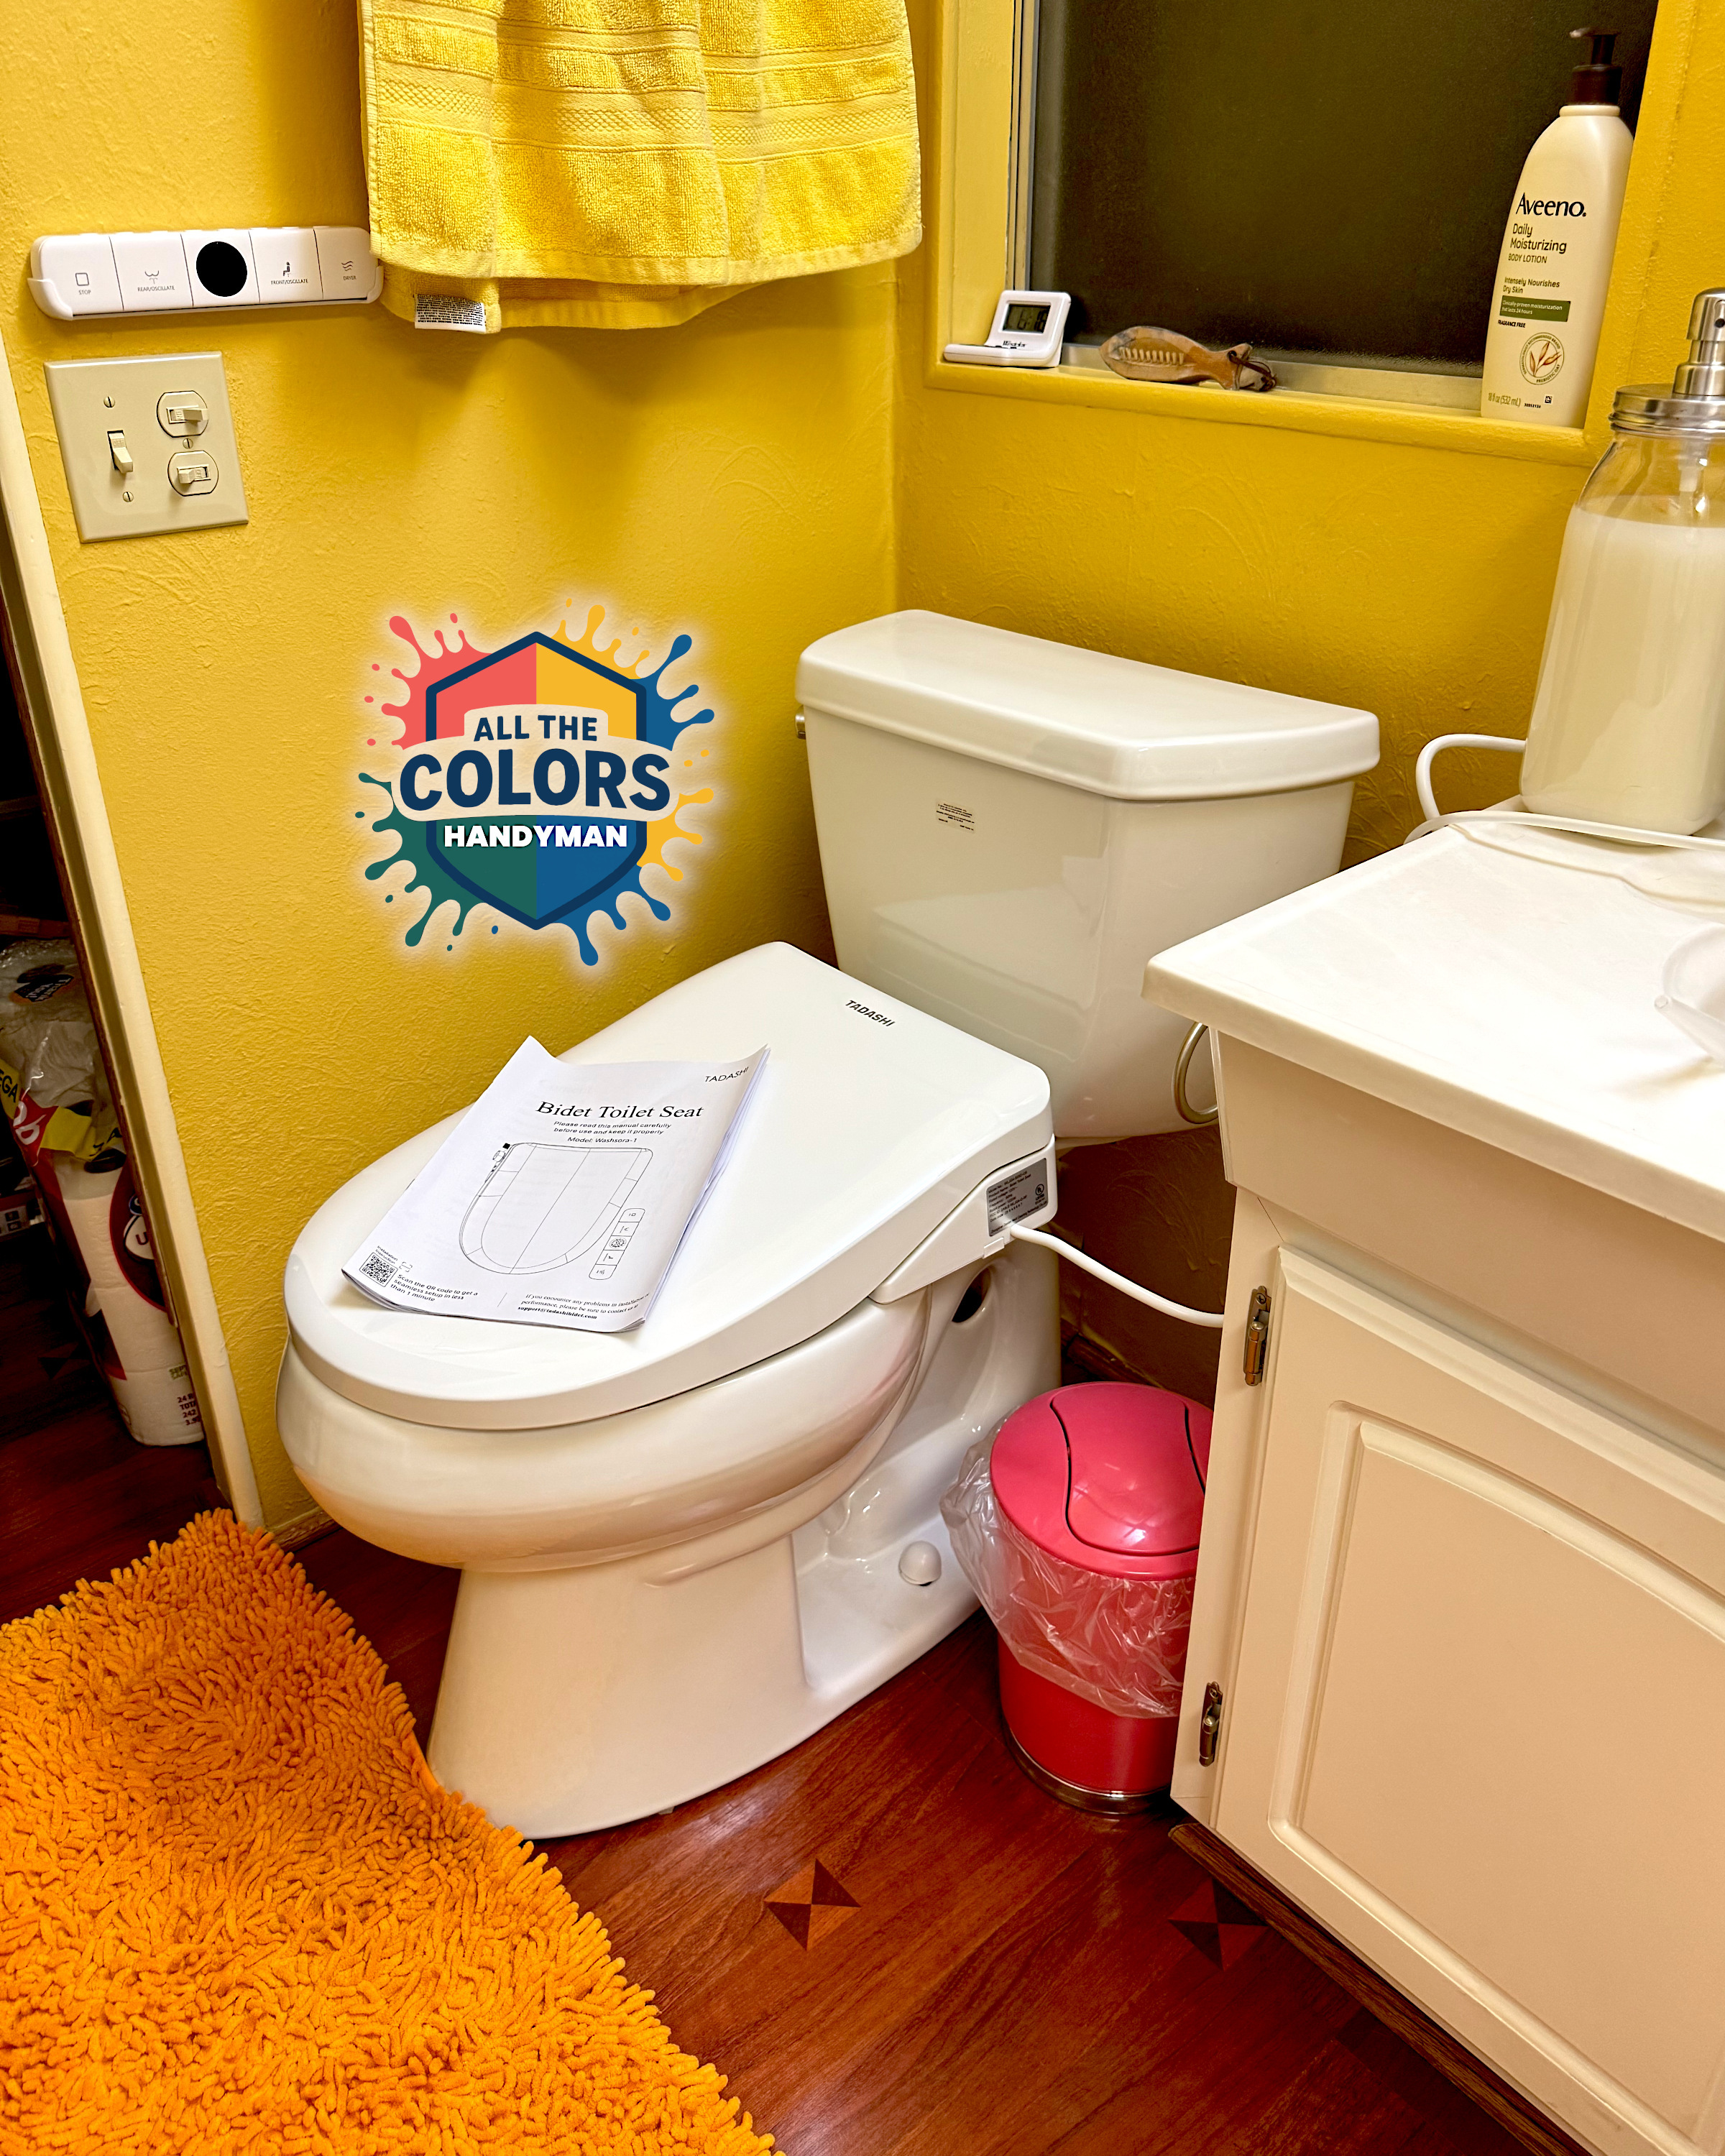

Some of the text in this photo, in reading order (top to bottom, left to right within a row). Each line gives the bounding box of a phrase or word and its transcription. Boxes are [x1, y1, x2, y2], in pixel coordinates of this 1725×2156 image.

[1512, 224, 1533, 238] Daily
[1510, 238, 1568, 254] Moisturizing
[1508, 253, 1522, 262] BODY
[1504, 277, 1560, 287] Intensely Nourishes
[1536, 372, 1556, 383] PREBIOTIC
[845, 1000, 896, 1027] TADASHI
[705, 1067, 749, 1082] TADASHI
[535, 1101, 704, 1118] Bidet Toilet Seat
[397, 1274, 413, 1284] Scan
[390, 1284, 405, 1294] than
[411, 1293, 436, 1302] minute
[394, 1279, 423, 1294] seamless
[518, 1307, 597, 1319] support@tadashibidet.com
[177, 1395, 187, 1404] 24
[183, 1409, 196, 1419] 242
